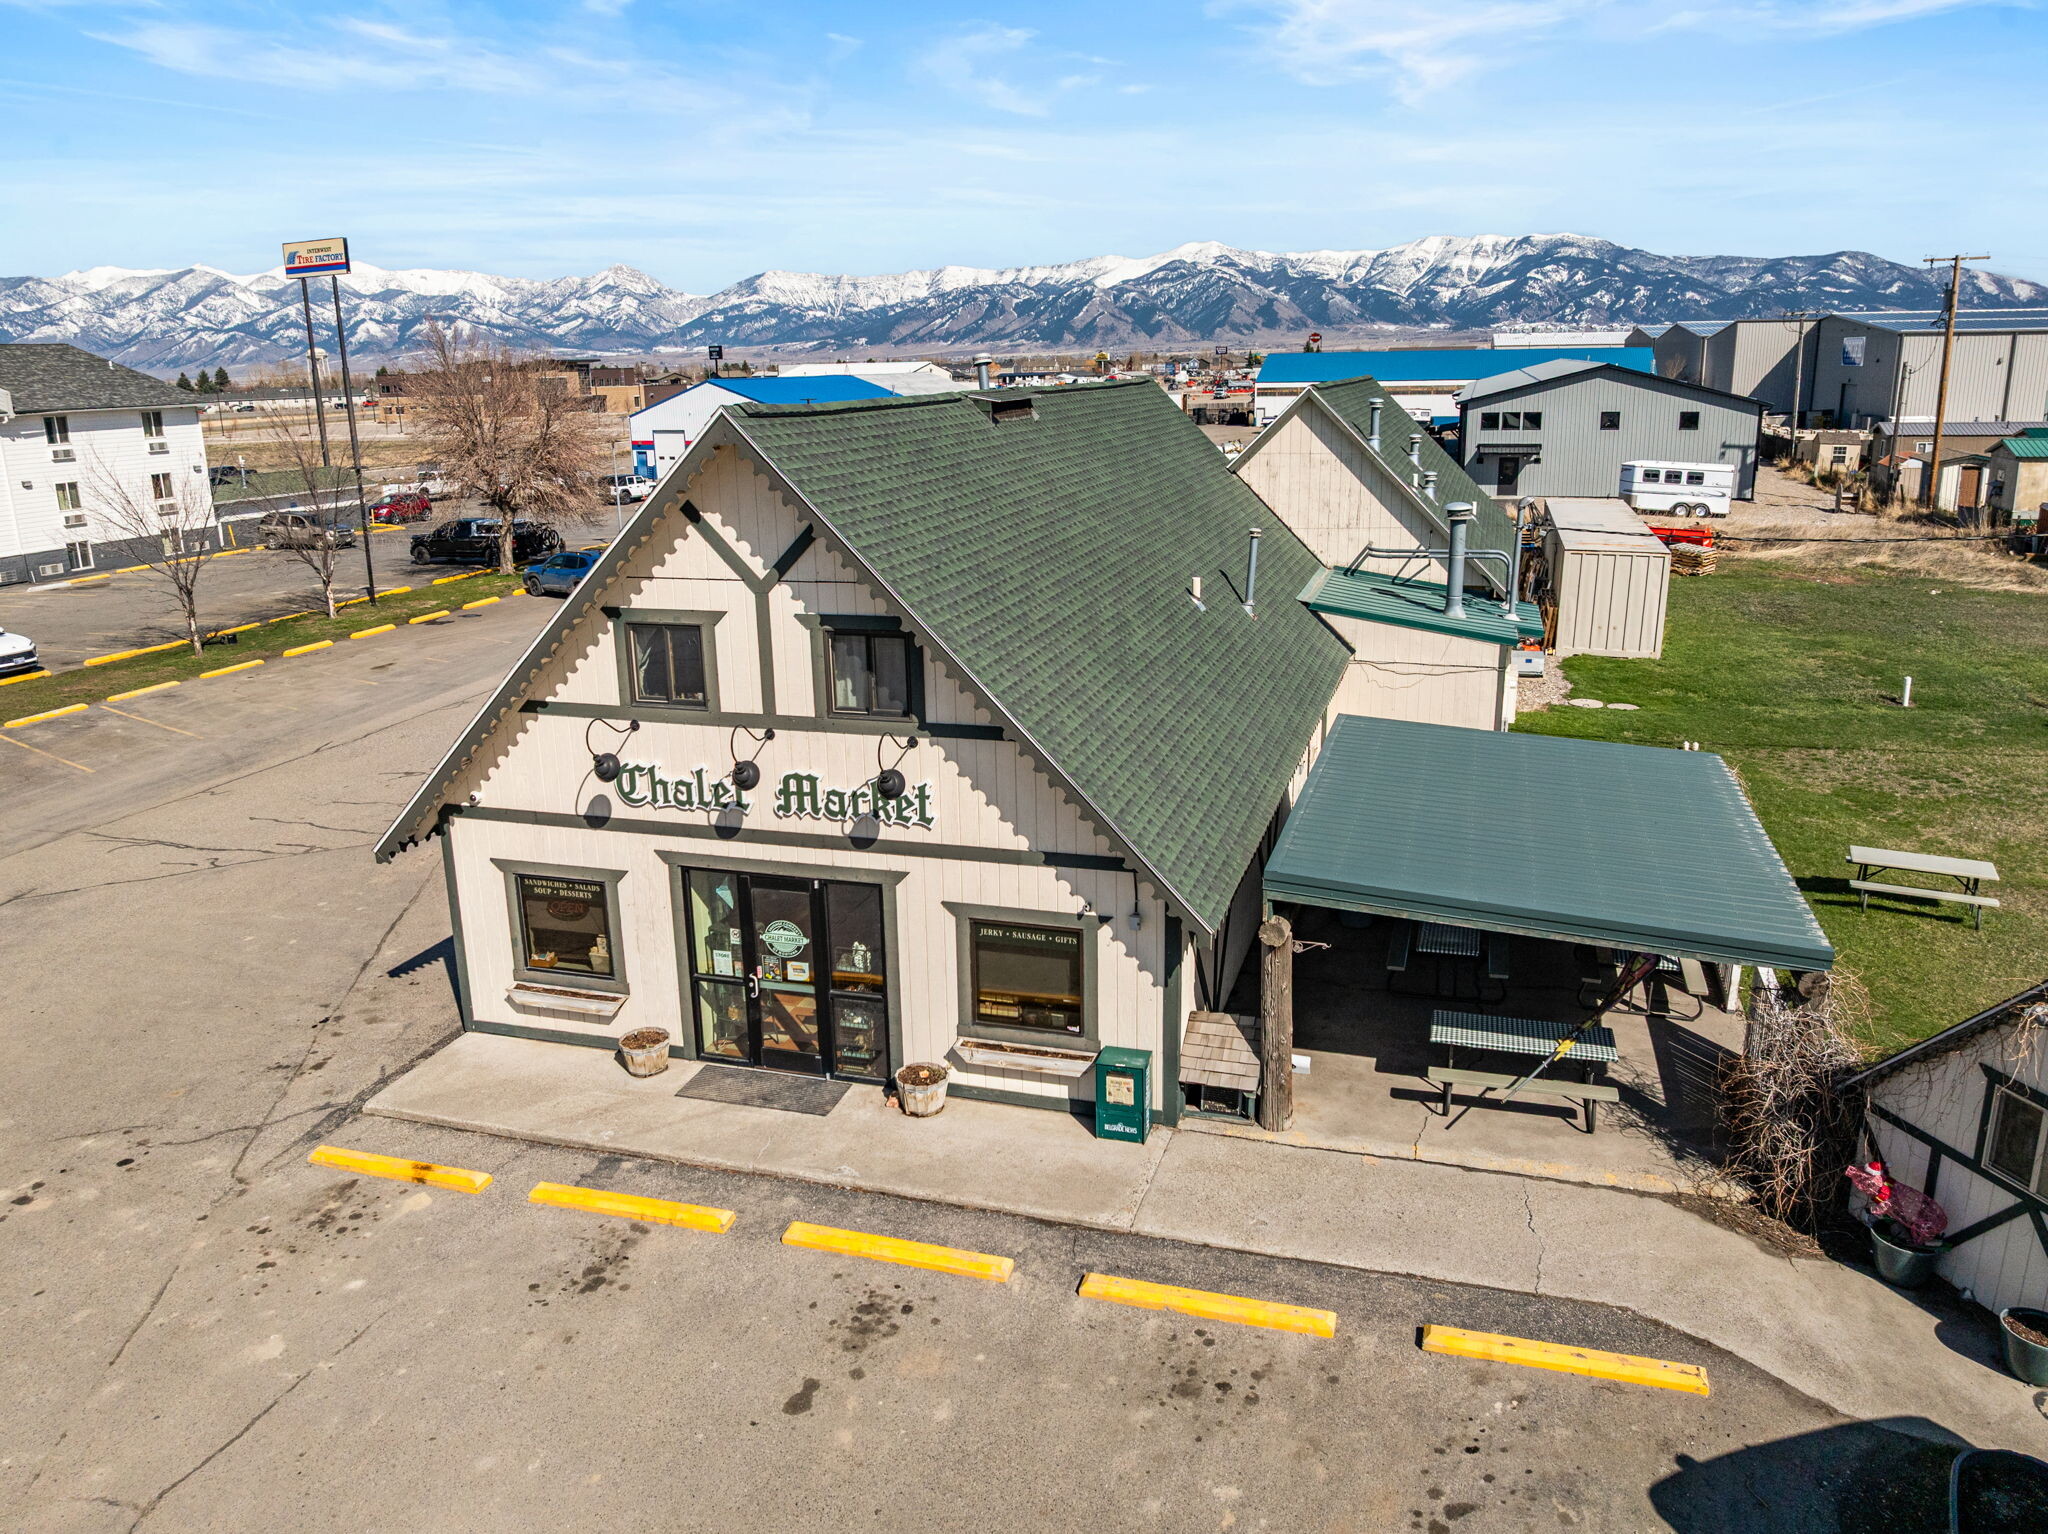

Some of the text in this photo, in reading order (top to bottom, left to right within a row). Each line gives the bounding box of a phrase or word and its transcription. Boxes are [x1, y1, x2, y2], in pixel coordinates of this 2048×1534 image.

[297, 253, 343, 264] TIRE FACTORY
[777, 772, 935, 826] Market
[524, 879, 601, 892] SANDWICHES SALADS
[534, 887, 592, 899] SOUP DESSERTS
[551, 901, 584, 913] OPEN
[765, 933, 804, 944] CHALET MARKET
[979, 928, 1078, 945] JERKY SAUSAGE GIFTS
